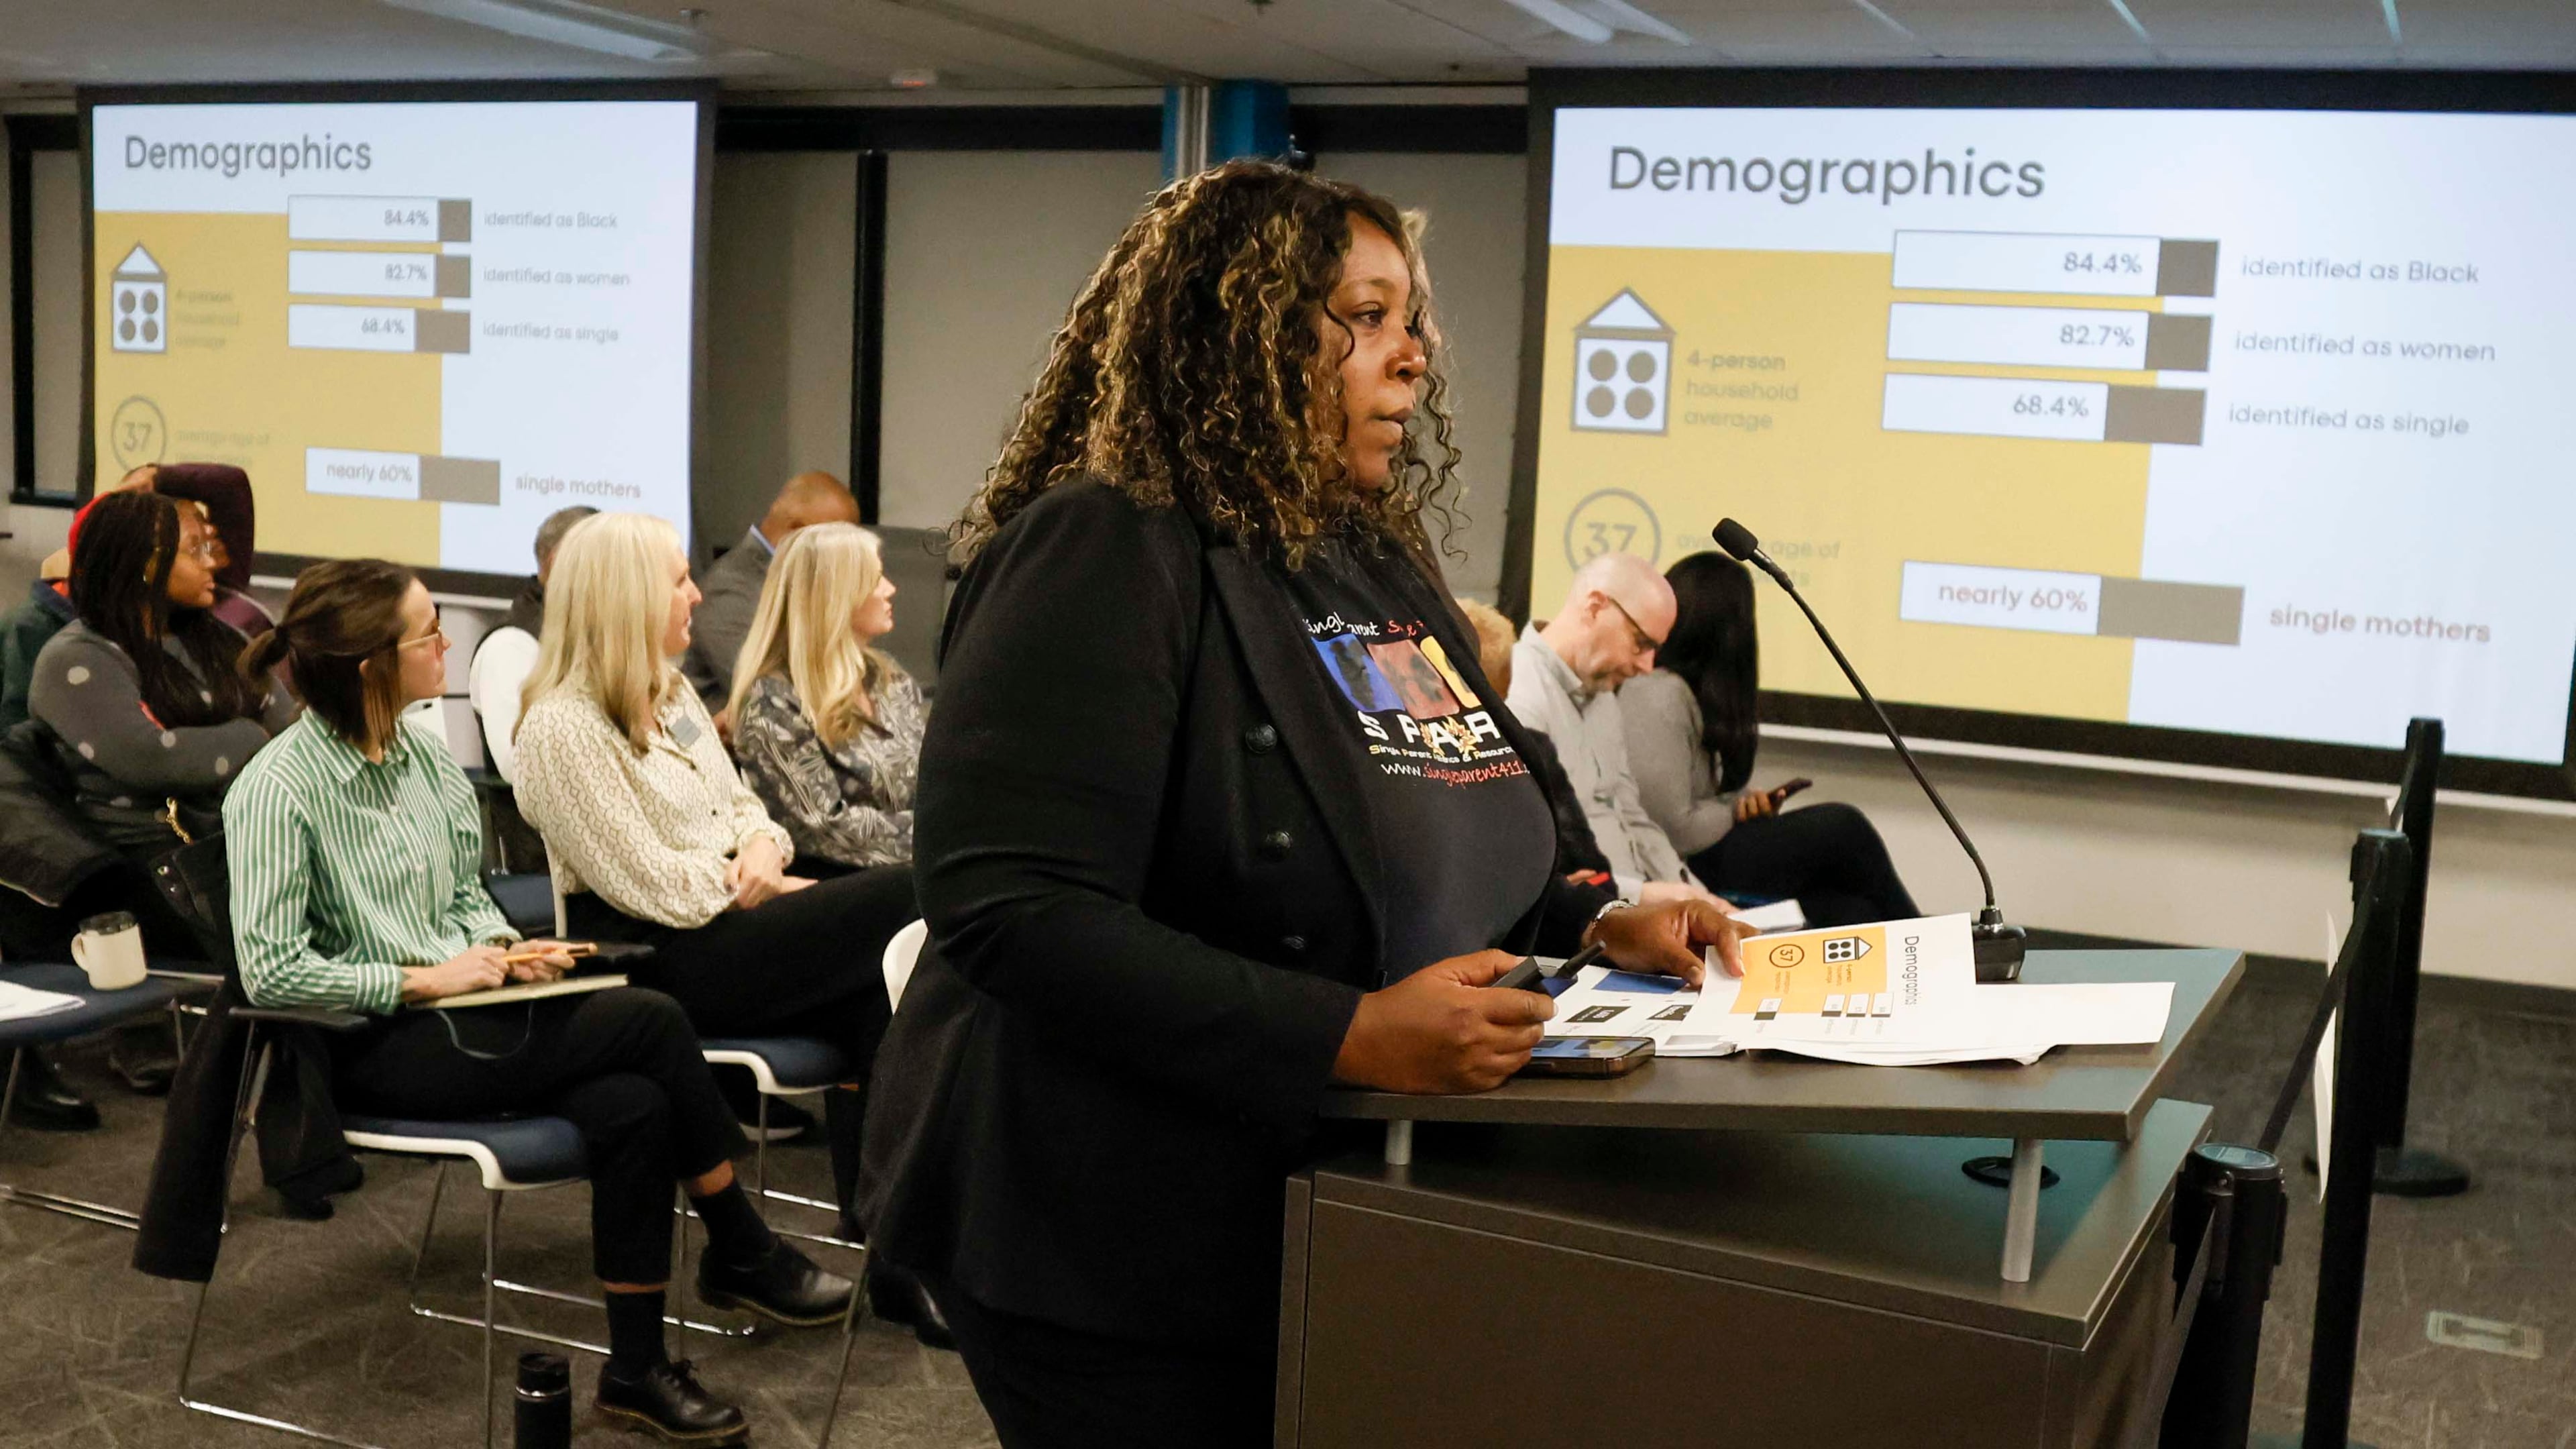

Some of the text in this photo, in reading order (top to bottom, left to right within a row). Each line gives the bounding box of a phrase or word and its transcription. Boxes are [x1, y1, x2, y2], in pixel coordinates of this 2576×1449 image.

[124, 133, 372, 176] Demographics
[1609, 146, 2045, 205] Demographics
[384, 209, 430, 226] 84.4%
[484, 211, 617, 229] identified as Black
[384, 264, 428, 280] 82.7%
[2063, 251, 2143, 275] 84.4%
[2241, 257, 2479, 284] identified as Black
[482, 267, 630, 286] identified as women
[361, 317, 406, 335] 68.4%
[482, 322, 619, 343] identified as single
[2059, 323, 2135, 348] 82.7%
[2235, 331, 2496, 362] identified as women
[1686, 349, 1786, 372] 4-person
[1684, 378, 1799, 402] household
[2012, 394, 2090, 419] 68.4%
[1683, 411, 1773, 433] average
[2228, 404, 2470, 439] identified as single
[122, 422, 152, 452] 37
[326, 462, 413, 483] nearly 60%
[515, 474, 642, 498] single mothers
[1584, 521, 1638, 560] 37
[1938, 582, 2088, 613] nearly 60%
[2269, 603, 2491, 644] single mothers
[1473, 746, 1515, 759] Resourc
[1779, 949, 1793, 962] 37
[1902, 935, 1921, 1006] Demographics
